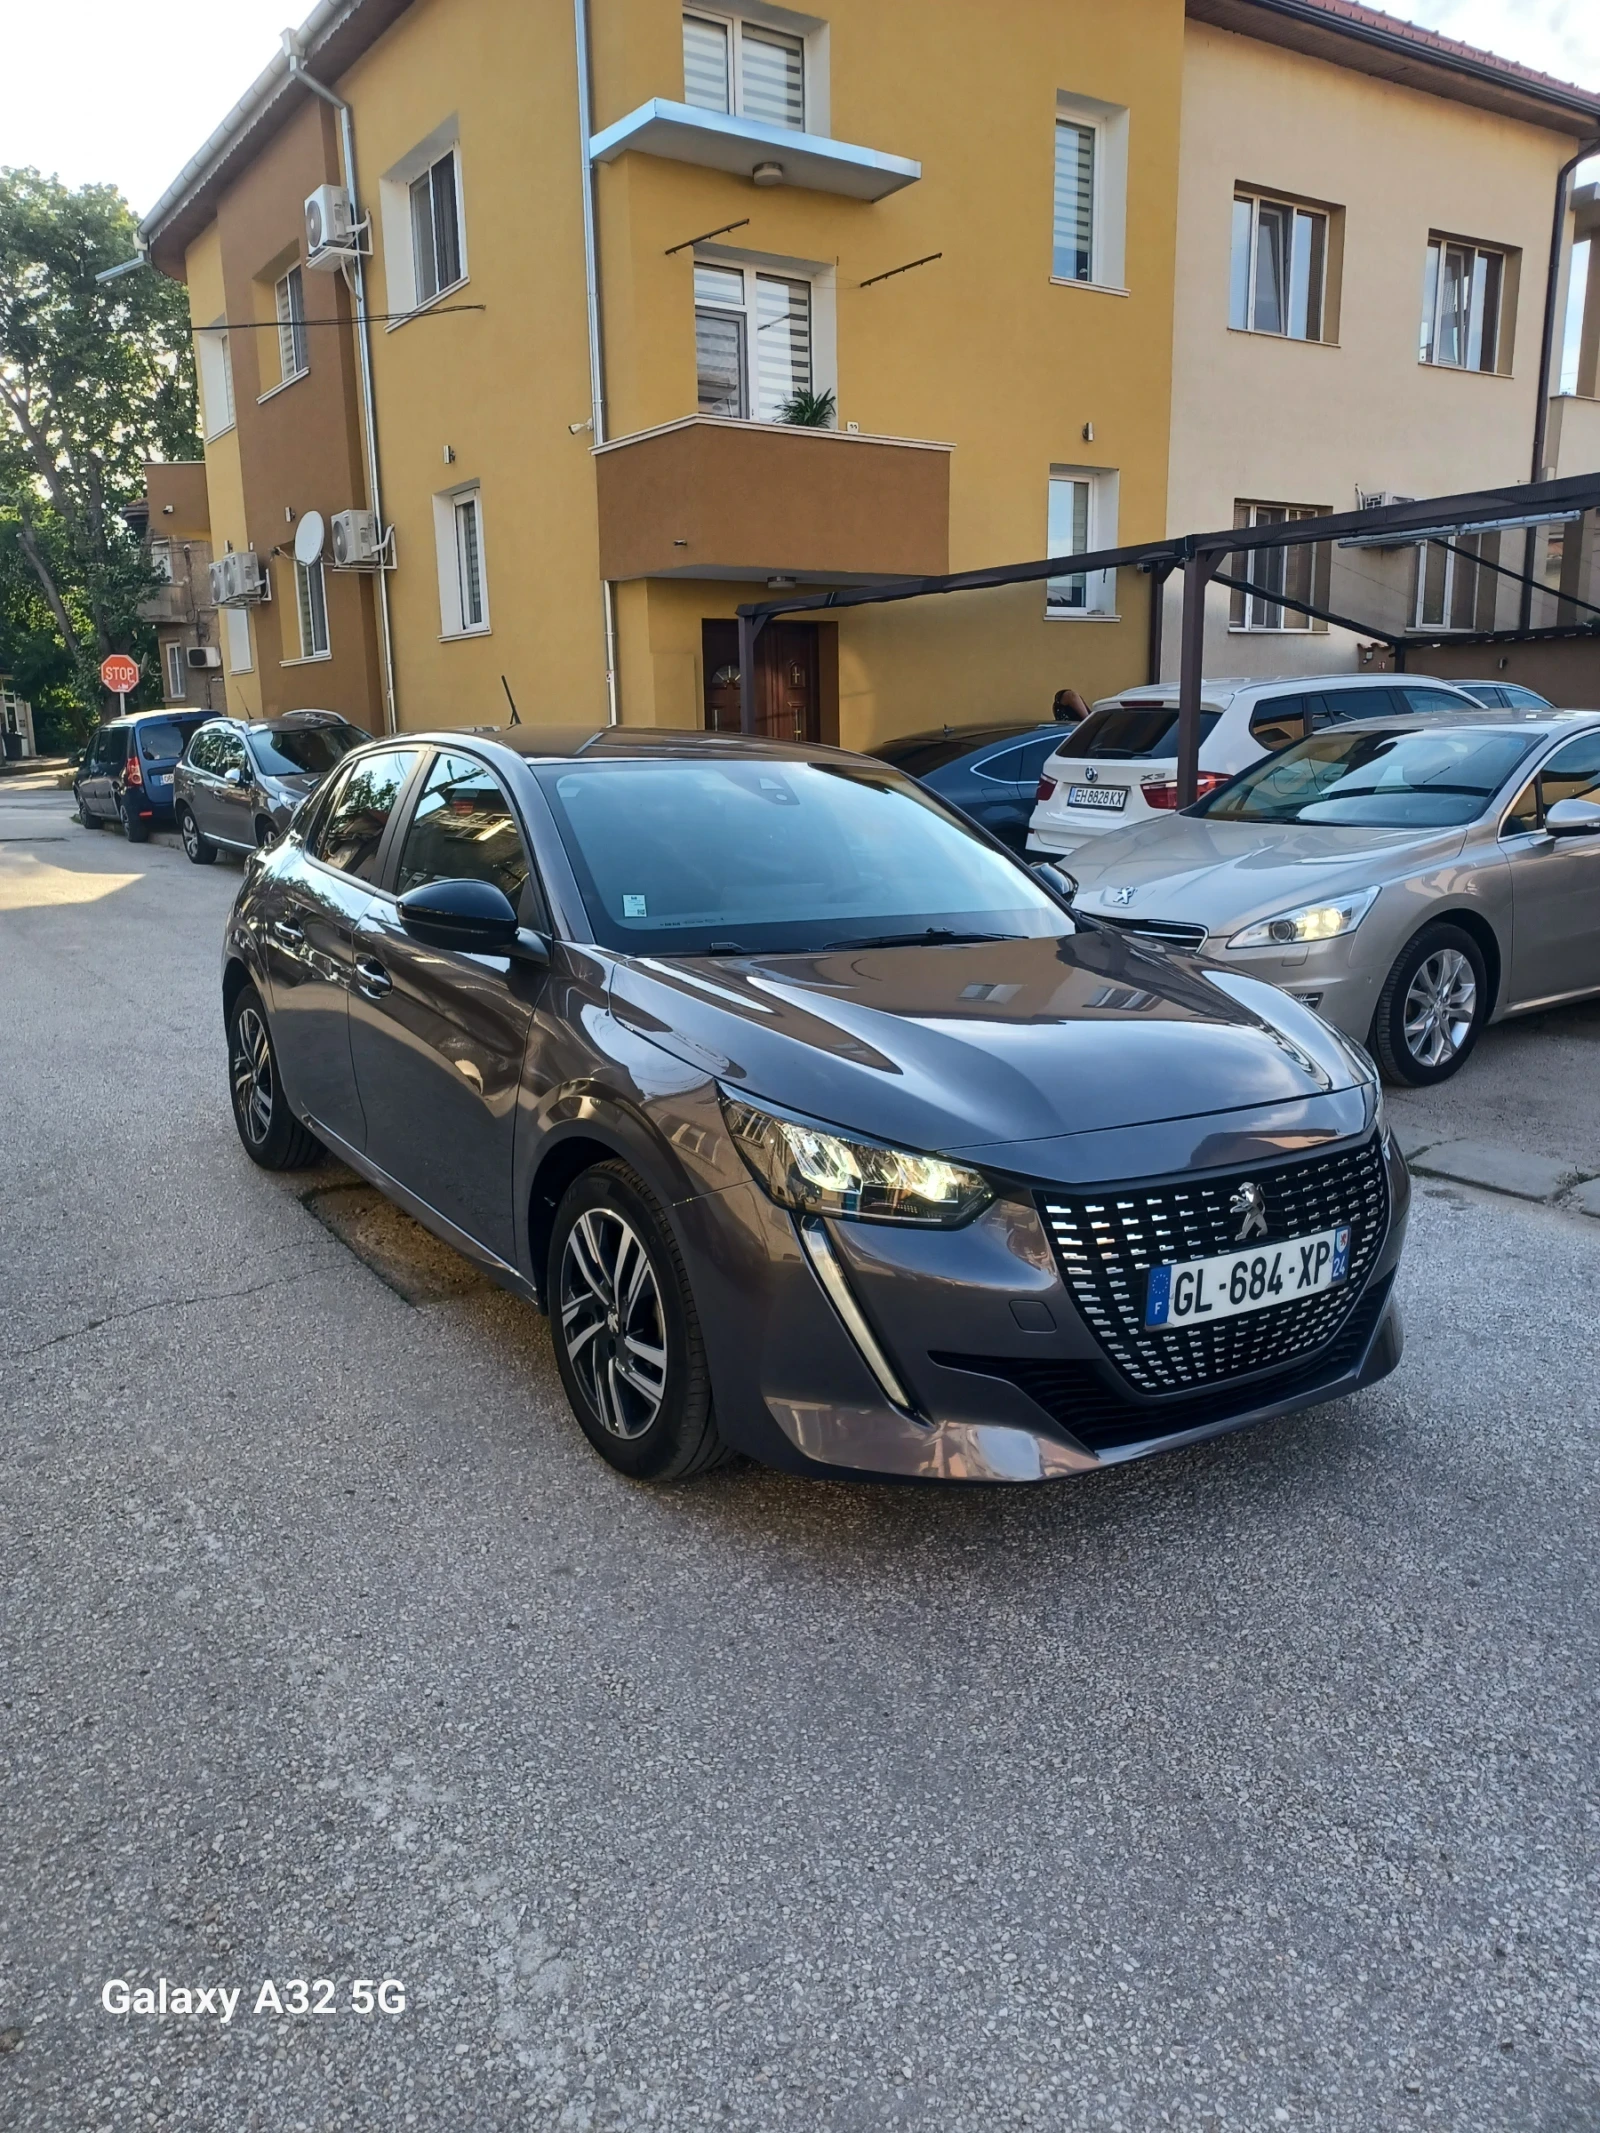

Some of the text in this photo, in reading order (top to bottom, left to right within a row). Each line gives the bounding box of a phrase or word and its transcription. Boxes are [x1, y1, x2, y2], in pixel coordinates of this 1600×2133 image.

[106, 667, 134, 680] STOP
[1140, 773, 1165, 781] X3
[1333, 1257, 1346, 1278] 24
[1174, 1241, 1330, 1316] GL-684-XP
[1154, 1301, 1163, 1315] F
